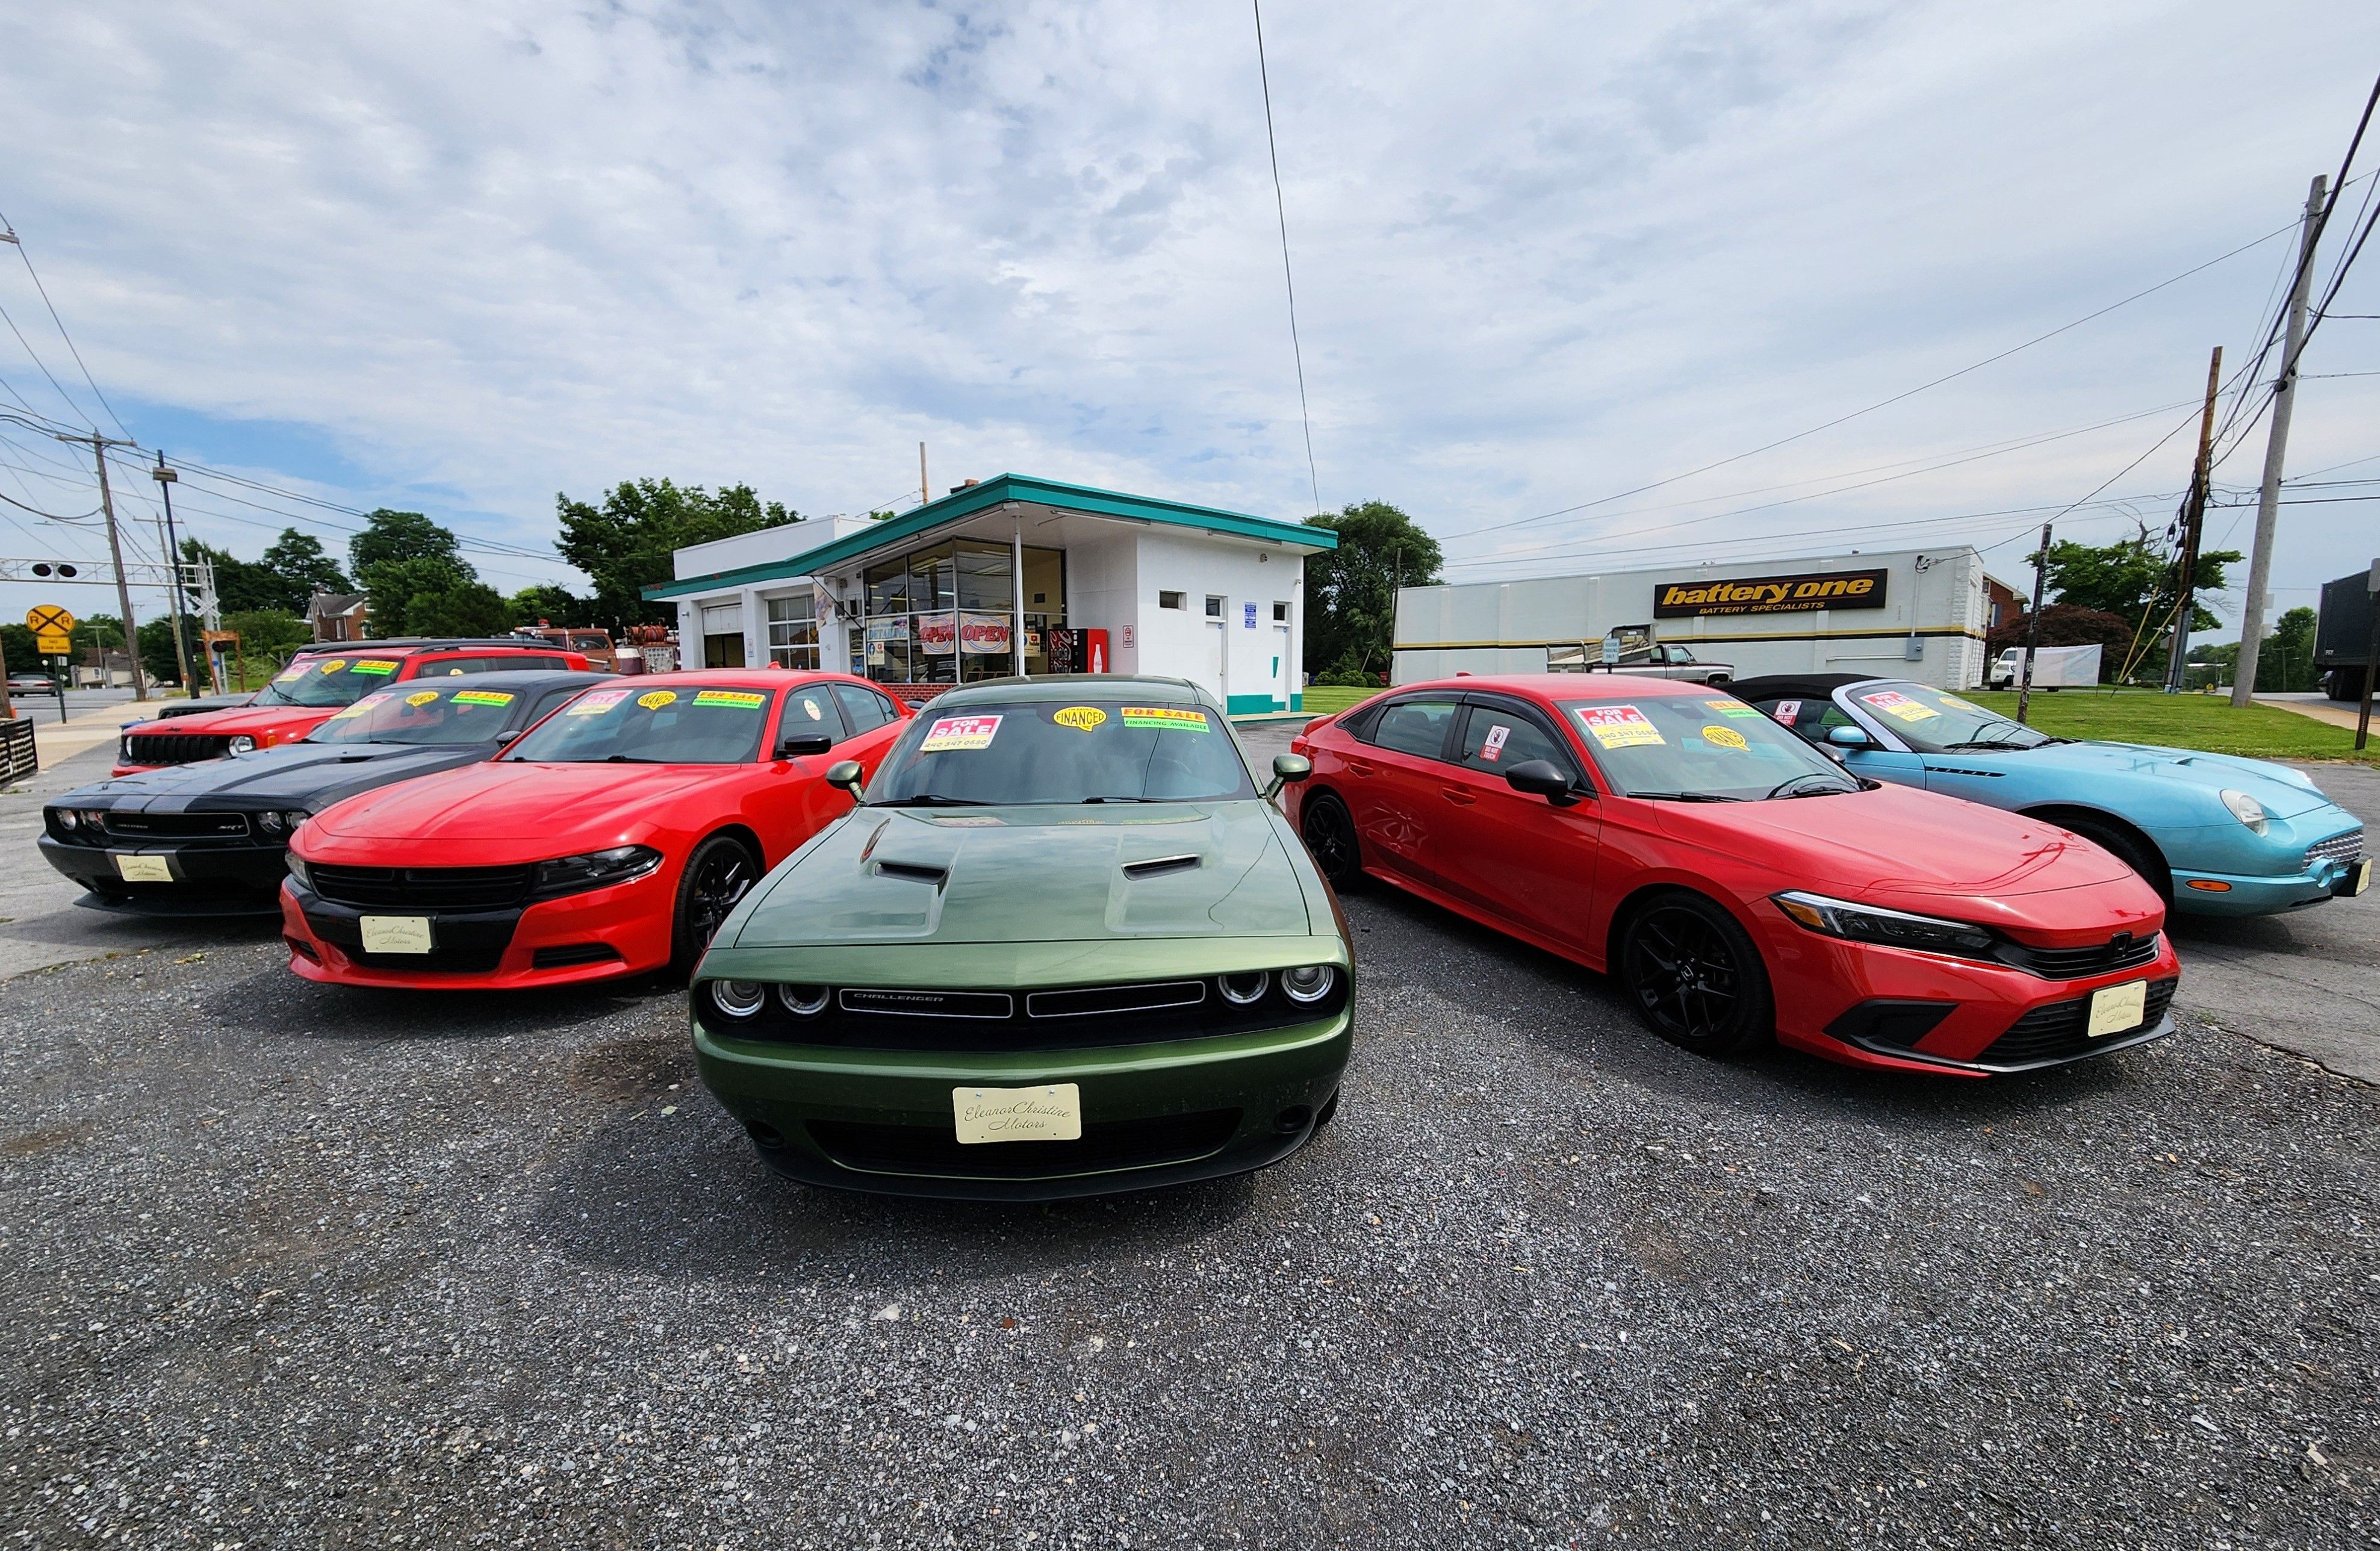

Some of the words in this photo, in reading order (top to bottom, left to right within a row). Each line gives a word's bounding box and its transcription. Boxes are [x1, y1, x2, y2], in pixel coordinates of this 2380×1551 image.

[1662, 583, 1792, 604] battery
[1794, 579, 1874, 597] one
[1699, 606, 1747, 614] BATTERY
[1751, 601, 1825, 612] SPECIALISTS
[30, 615, 39, 624] R
[61, 616, 70, 624] R
[919, 624, 954, 643] OPEN
[962, 624, 1010, 642] OPEN
[1057, 711, 1104, 725] FINANCED
[1163, 710, 1203, 720] SALE
[1589, 714, 1644, 726] SALE
[951, 720, 980, 728] FOR
[932, 725, 992, 738] SALE
[854, 993, 943, 1002] CHALLENGER
[987, 1117, 1046, 1130] Motors
